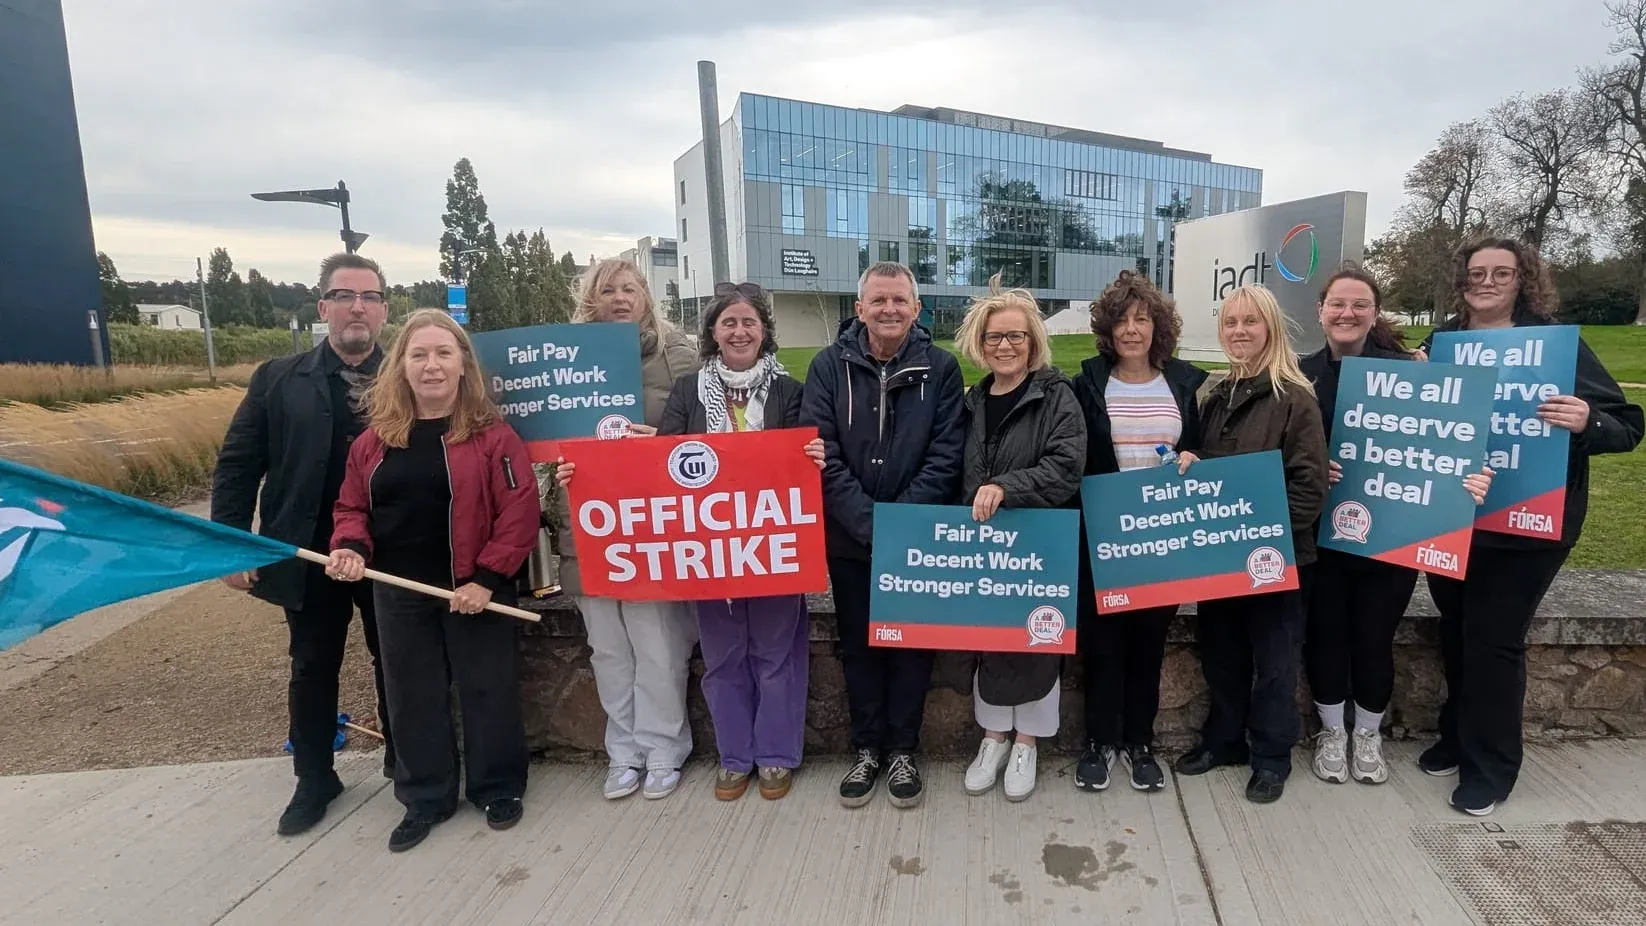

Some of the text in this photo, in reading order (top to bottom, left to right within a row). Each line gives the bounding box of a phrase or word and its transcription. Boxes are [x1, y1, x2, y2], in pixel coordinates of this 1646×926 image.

[1213, 251, 1272, 301] iadt
[508, 343, 580, 365] Fair Pay
[1454, 340, 1544, 367] We all
[492, 365, 607, 392] Decent Work
[1366, 371, 1462, 404] We all
[496, 391, 636, 418] onger Services
[1343, 403, 1475, 442] deserve
[1490, 412, 1551, 437] tter
[1339, 437, 1471, 476] a better
[1482, 444, 1520, 470] al
[1141, 479, 1223, 503] Fair Pay
[1363, 472, 1433, 506] deal
[578, 487, 817, 537] OFFICIAL
[1119, 498, 1253, 532] Decent Work
[1508, 506, 1553, 533] FÓRSA
[934, 523, 1018, 547] Fair Pay
[1097, 523, 1284, 560] Stronger Services
[604, 532, 800, 582] STRIKE
[907, 548, 1043, 571] Decent Work
[1416, 543, 1459, 572] FÓRSA
[879, 573, 1070, 598] Stronger Services
[1103, 591, 1130, 608] FÓRSA
[875, 625, 903, 641] FÓRSA
